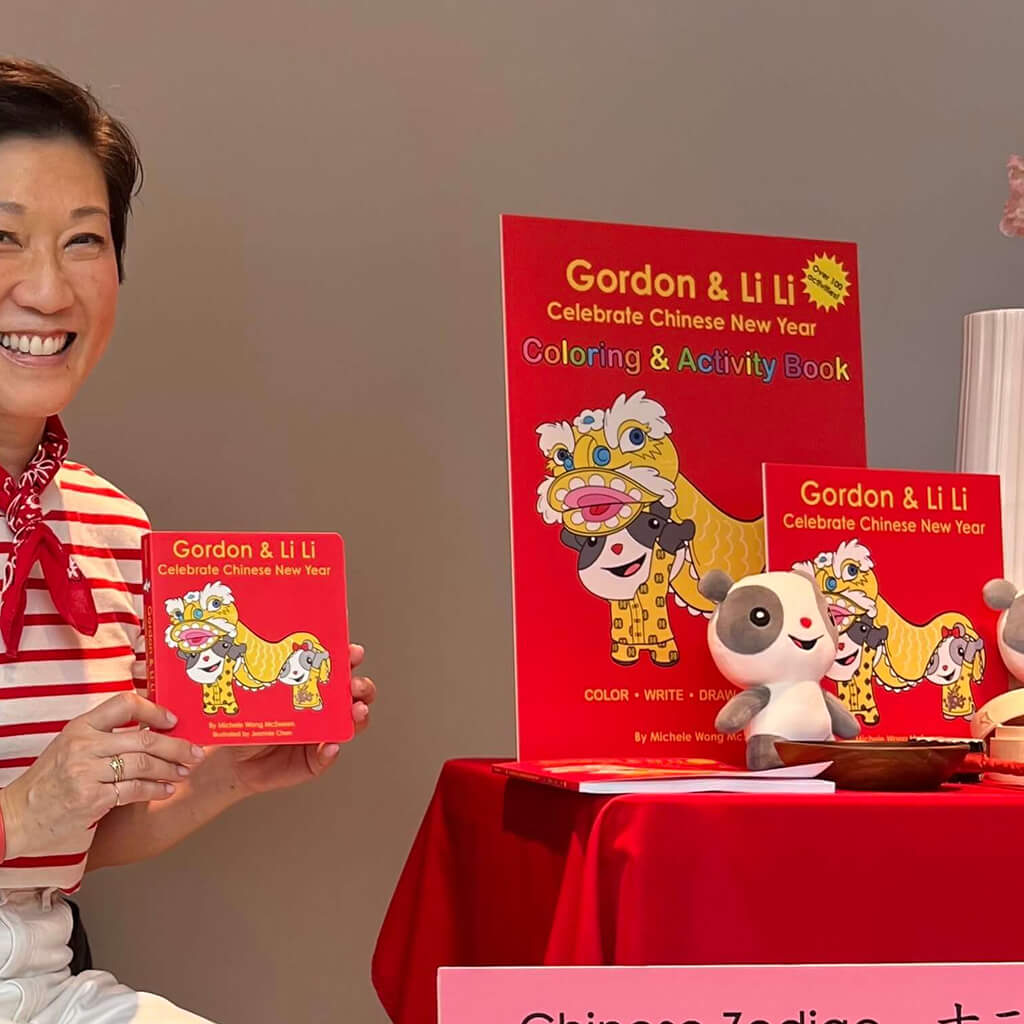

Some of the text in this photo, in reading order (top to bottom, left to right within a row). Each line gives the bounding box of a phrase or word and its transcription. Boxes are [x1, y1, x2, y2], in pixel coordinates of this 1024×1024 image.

[566, 259, 795, 306] Gordon & Li Li
[547, 301, 817, 337] Celebrate Chinese New Year
[522, 337, 851, 384] Coloring & Activity Book
[800, 480, 968, 512] Gordon & Li Li
[783, 513, 986, 535] Celebrate Chinese New Year
[173, 540, 316, 559] Gordon & Li Li
[158, 564, 331, 577] Celebrate Chinese New Year
[584, 688, 737, 702] COLOR WRITE DRAW
[634, 731, 647, 744] By
[650, 731, 692, 743] Michele
[695, 731, 724, 744] Wong
